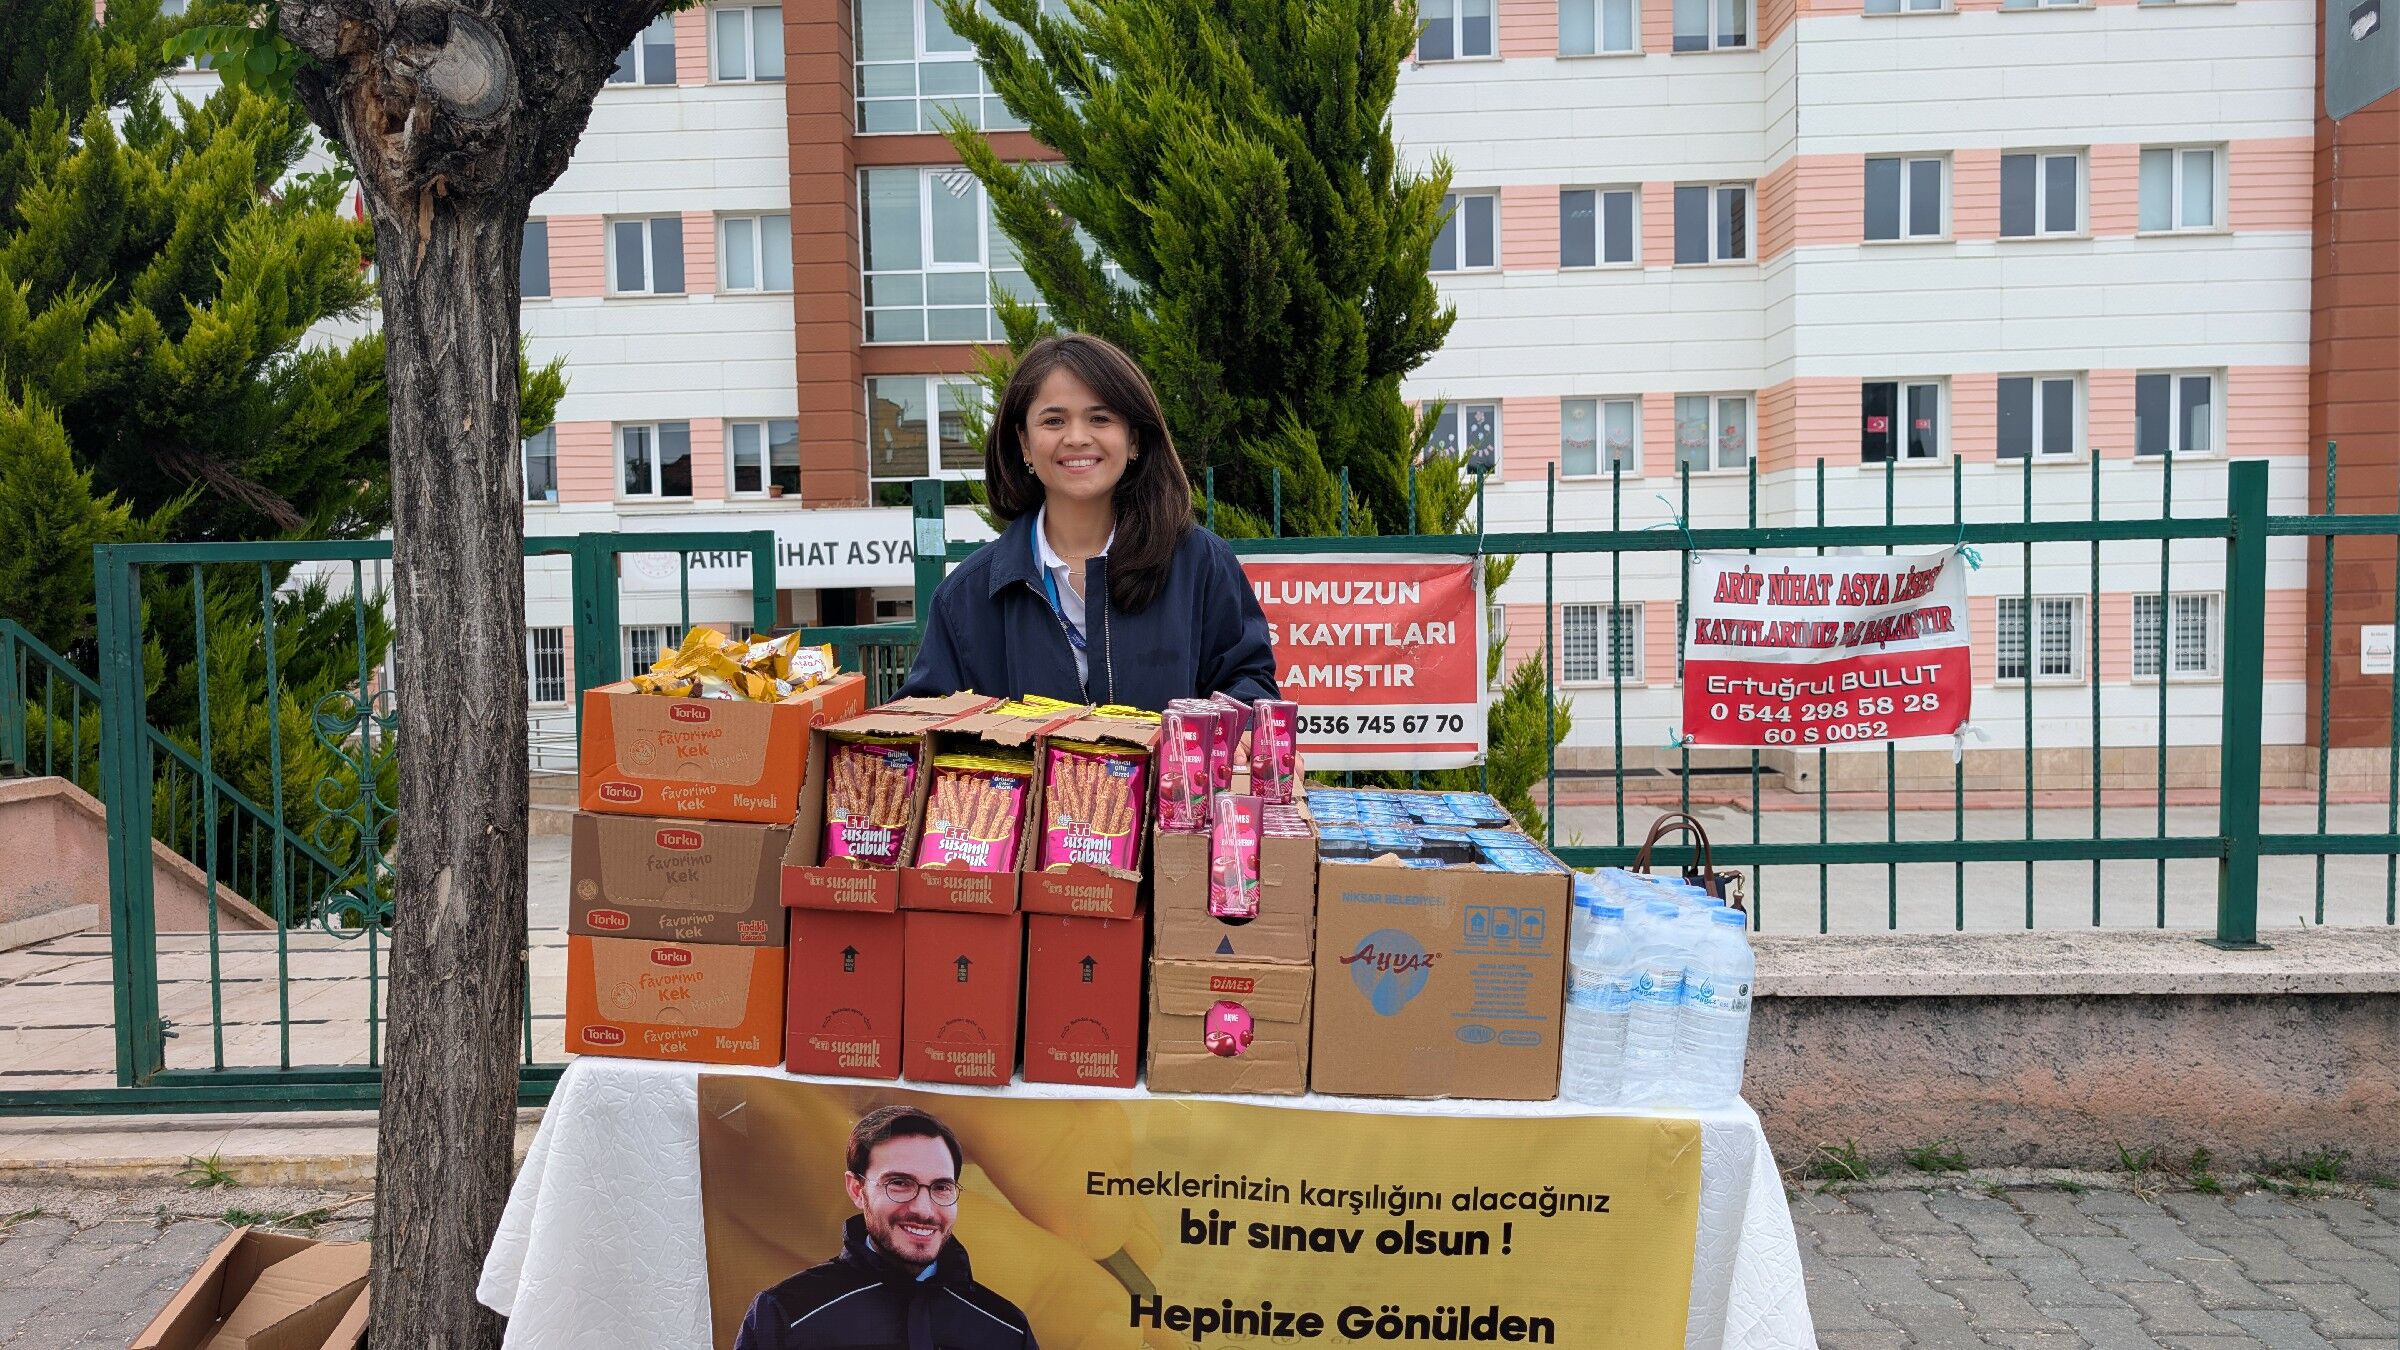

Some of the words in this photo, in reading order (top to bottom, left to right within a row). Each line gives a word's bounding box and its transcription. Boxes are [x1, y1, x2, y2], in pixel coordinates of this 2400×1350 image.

[778, 538, 839, 567] İHAT
[847, 541, 914, 565] ASYA
[1714, 564, 1764, 606] ARİF
[1767, 566, 1833, 606] NİHAT
[1836, 572, 1889, 606] ASYA
[1290, 621, 1455, 646] KAYITLARI
[1694, 618, 1839, 648] KAYITLARIMIZ
[1708, 675, 1835, 701] Ertuğrul
[1841, 664, 1942, 691] BULUT
[673, 705, 706, 719] Torku
[1710, 703, 1729, 721] 0
[1738, 704, 1792, 723] 544
[1801, 701, 1849, 722] 298
[1858, 697, 1894, 716] 58
[1903, 694, 1940, 713] 28
[1296, 715, 1349, 734] 0536
[1356, 715, 1396, 734] 745
[1402, 715, 1429, 733] 67
[1436, 714, 1464, 733] 70
[658, 727, 722, 747] favorimo
[1764, 728, 1796, 744] 60
[1803, 727, 1820, 743] S
[1826, 722, 1889, 741] 0052
[605, 785, 637, 799] Torku
[661, 784, 717, 801] favorimo
[733, 793, 777, 811] Meyveli
[662, 833, 698, 847] Torku
[841, 828, 891, 843] susamlı
[1063, 835, 1112, 850] susamlı
[848, 841, 892, 856] çubuk
[939, 838, 990, 853] susamlı
[647, 852, 712, 872] favorimo
[1070, 848, 1112, 865] çubuk
[826, 875, 877, 890] susamlı
[943, 876, 992, 890] susamlı
[833, 889, 878, 904] çubuk
[950, 889, 993, 904] çubuk
[1064, 884, 1113, 899] susamlı
[1071, 898, 1114, 913] çubuk
[593, 913, 625, 926] Torku
[659, 912, 715, 928] favorimo
[655, 951, 687, 963] Torku
[639, 970, 704, 989] favorimo
[587, 1028, 619, 1041] Torku
[643, 1028, 699, 1044] favorimo
[715, 1036, 760, 1052] Meyveli
[831, 1039, 880, 1054] susamlı
[838, 1052, 882, 1068] çubuk
[946, 1049, 995, 1064] susamlı
[1069, 1050, 1118, 1065] susamlı
[954, 1062, 997, 1078] çubuk
[1077, 1063, 1120, 1078] çubuk
[1087, 1171, 1290, 1204] Emeklerinizin
[1299, 1179, 1442, 1217] karşılığını
[1452, 1186, 1610, 1218] alacağınız
[1181, 1208, 1236, 1246] bir
[1247, 1221, 1363, 1253] sınav
[1375, 1221, 1489, 1256] olsun
[1503, 1221, 1513, 1255] !
[1130, 1293, 1324, 1342] Hepinize
[1337, 1304, 1556, 1344] Gönülden
